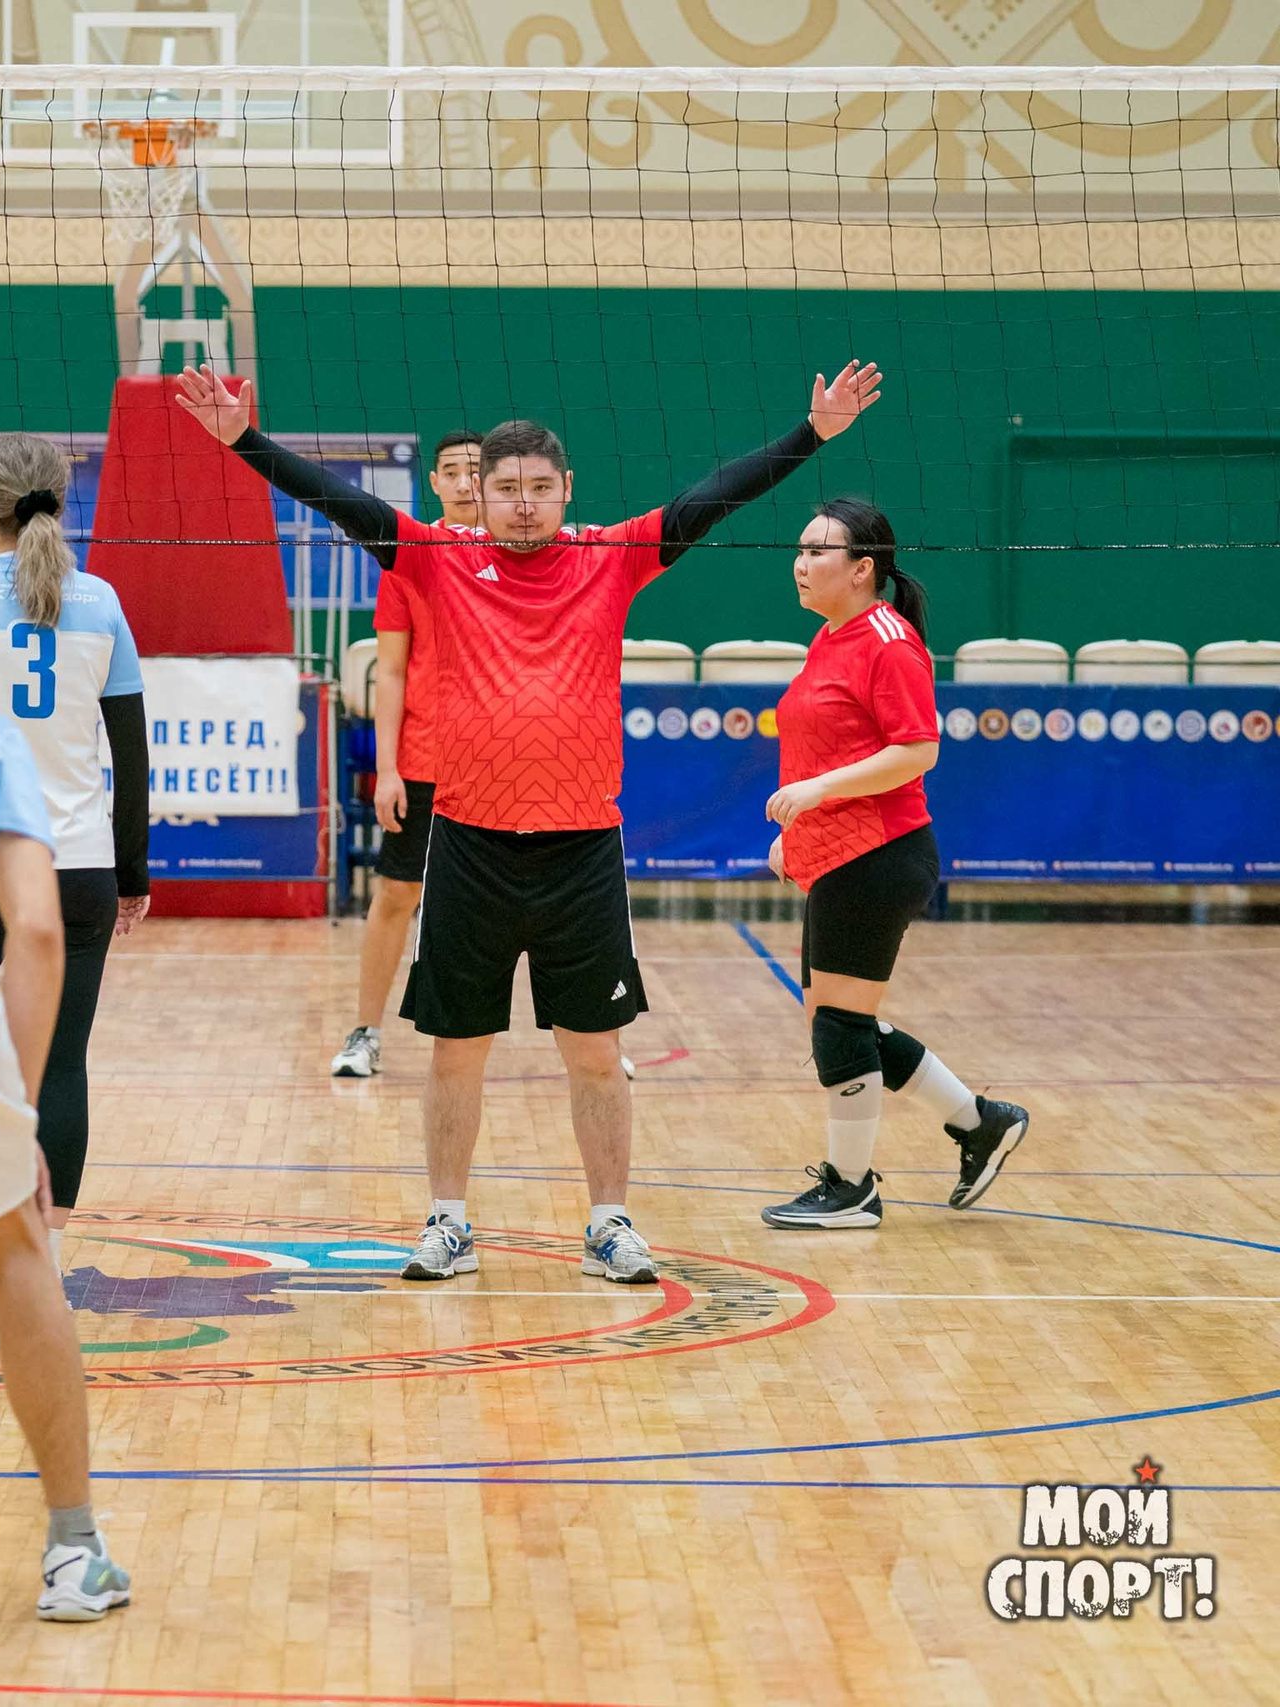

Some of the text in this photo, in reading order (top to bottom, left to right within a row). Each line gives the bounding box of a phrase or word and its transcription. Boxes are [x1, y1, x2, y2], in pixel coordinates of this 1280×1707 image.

[11, 622, 57, 719] 3
[101, 763, 288, 793] ПИНЕСЁТ!!
[279, 1344, 607, 1375] ВИДОВ
